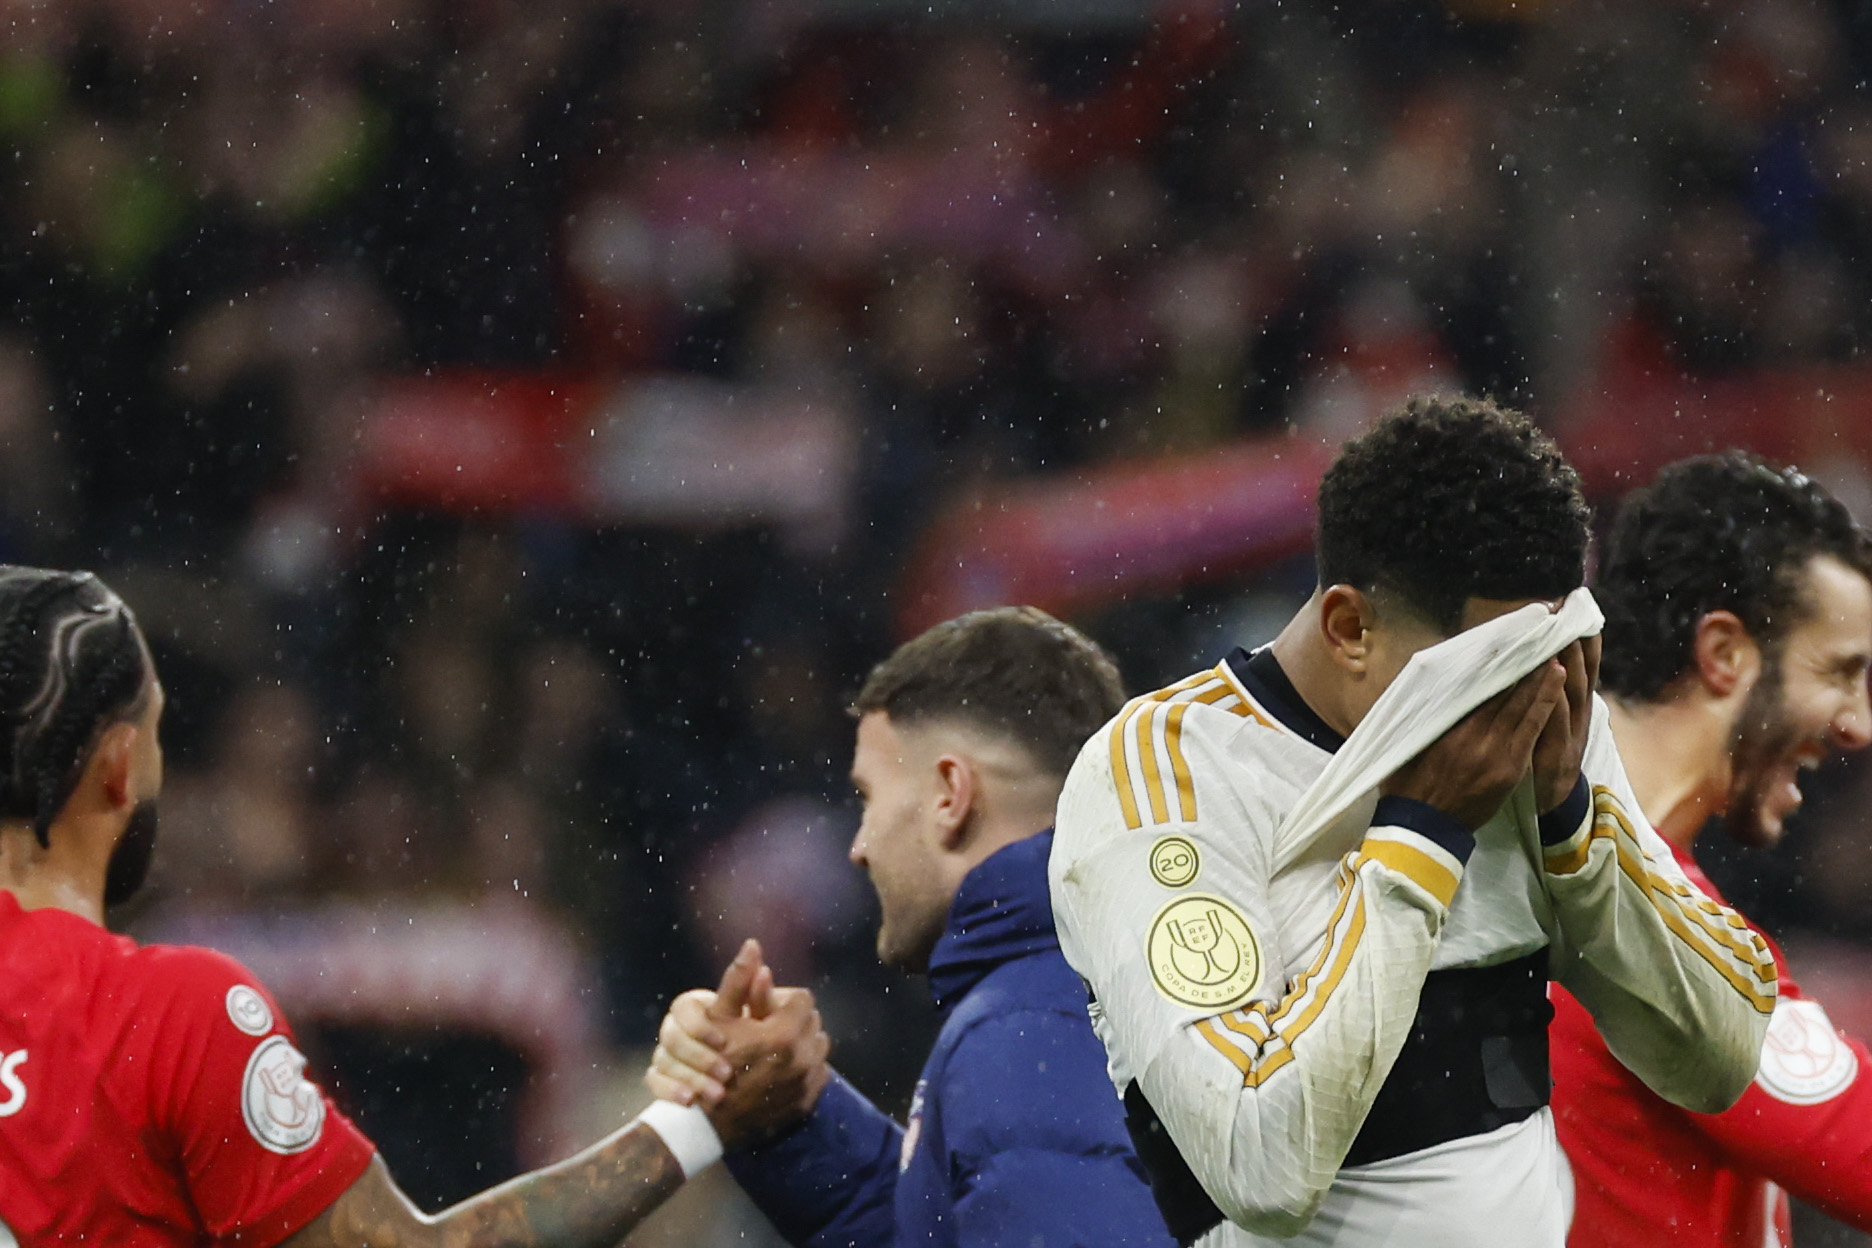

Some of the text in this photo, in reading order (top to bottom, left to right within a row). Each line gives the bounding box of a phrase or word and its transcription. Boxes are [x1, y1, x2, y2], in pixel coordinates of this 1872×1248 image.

[1160, 854, 1189, 872] 20
[1241, 943, 1250, 966] REY
[1161, 964, 1187, 992] COPA
[1240, 971, 1250, 983] EL
[1191, 989, 1208, 998] DE
[0, 1049, 29, 1117] S
